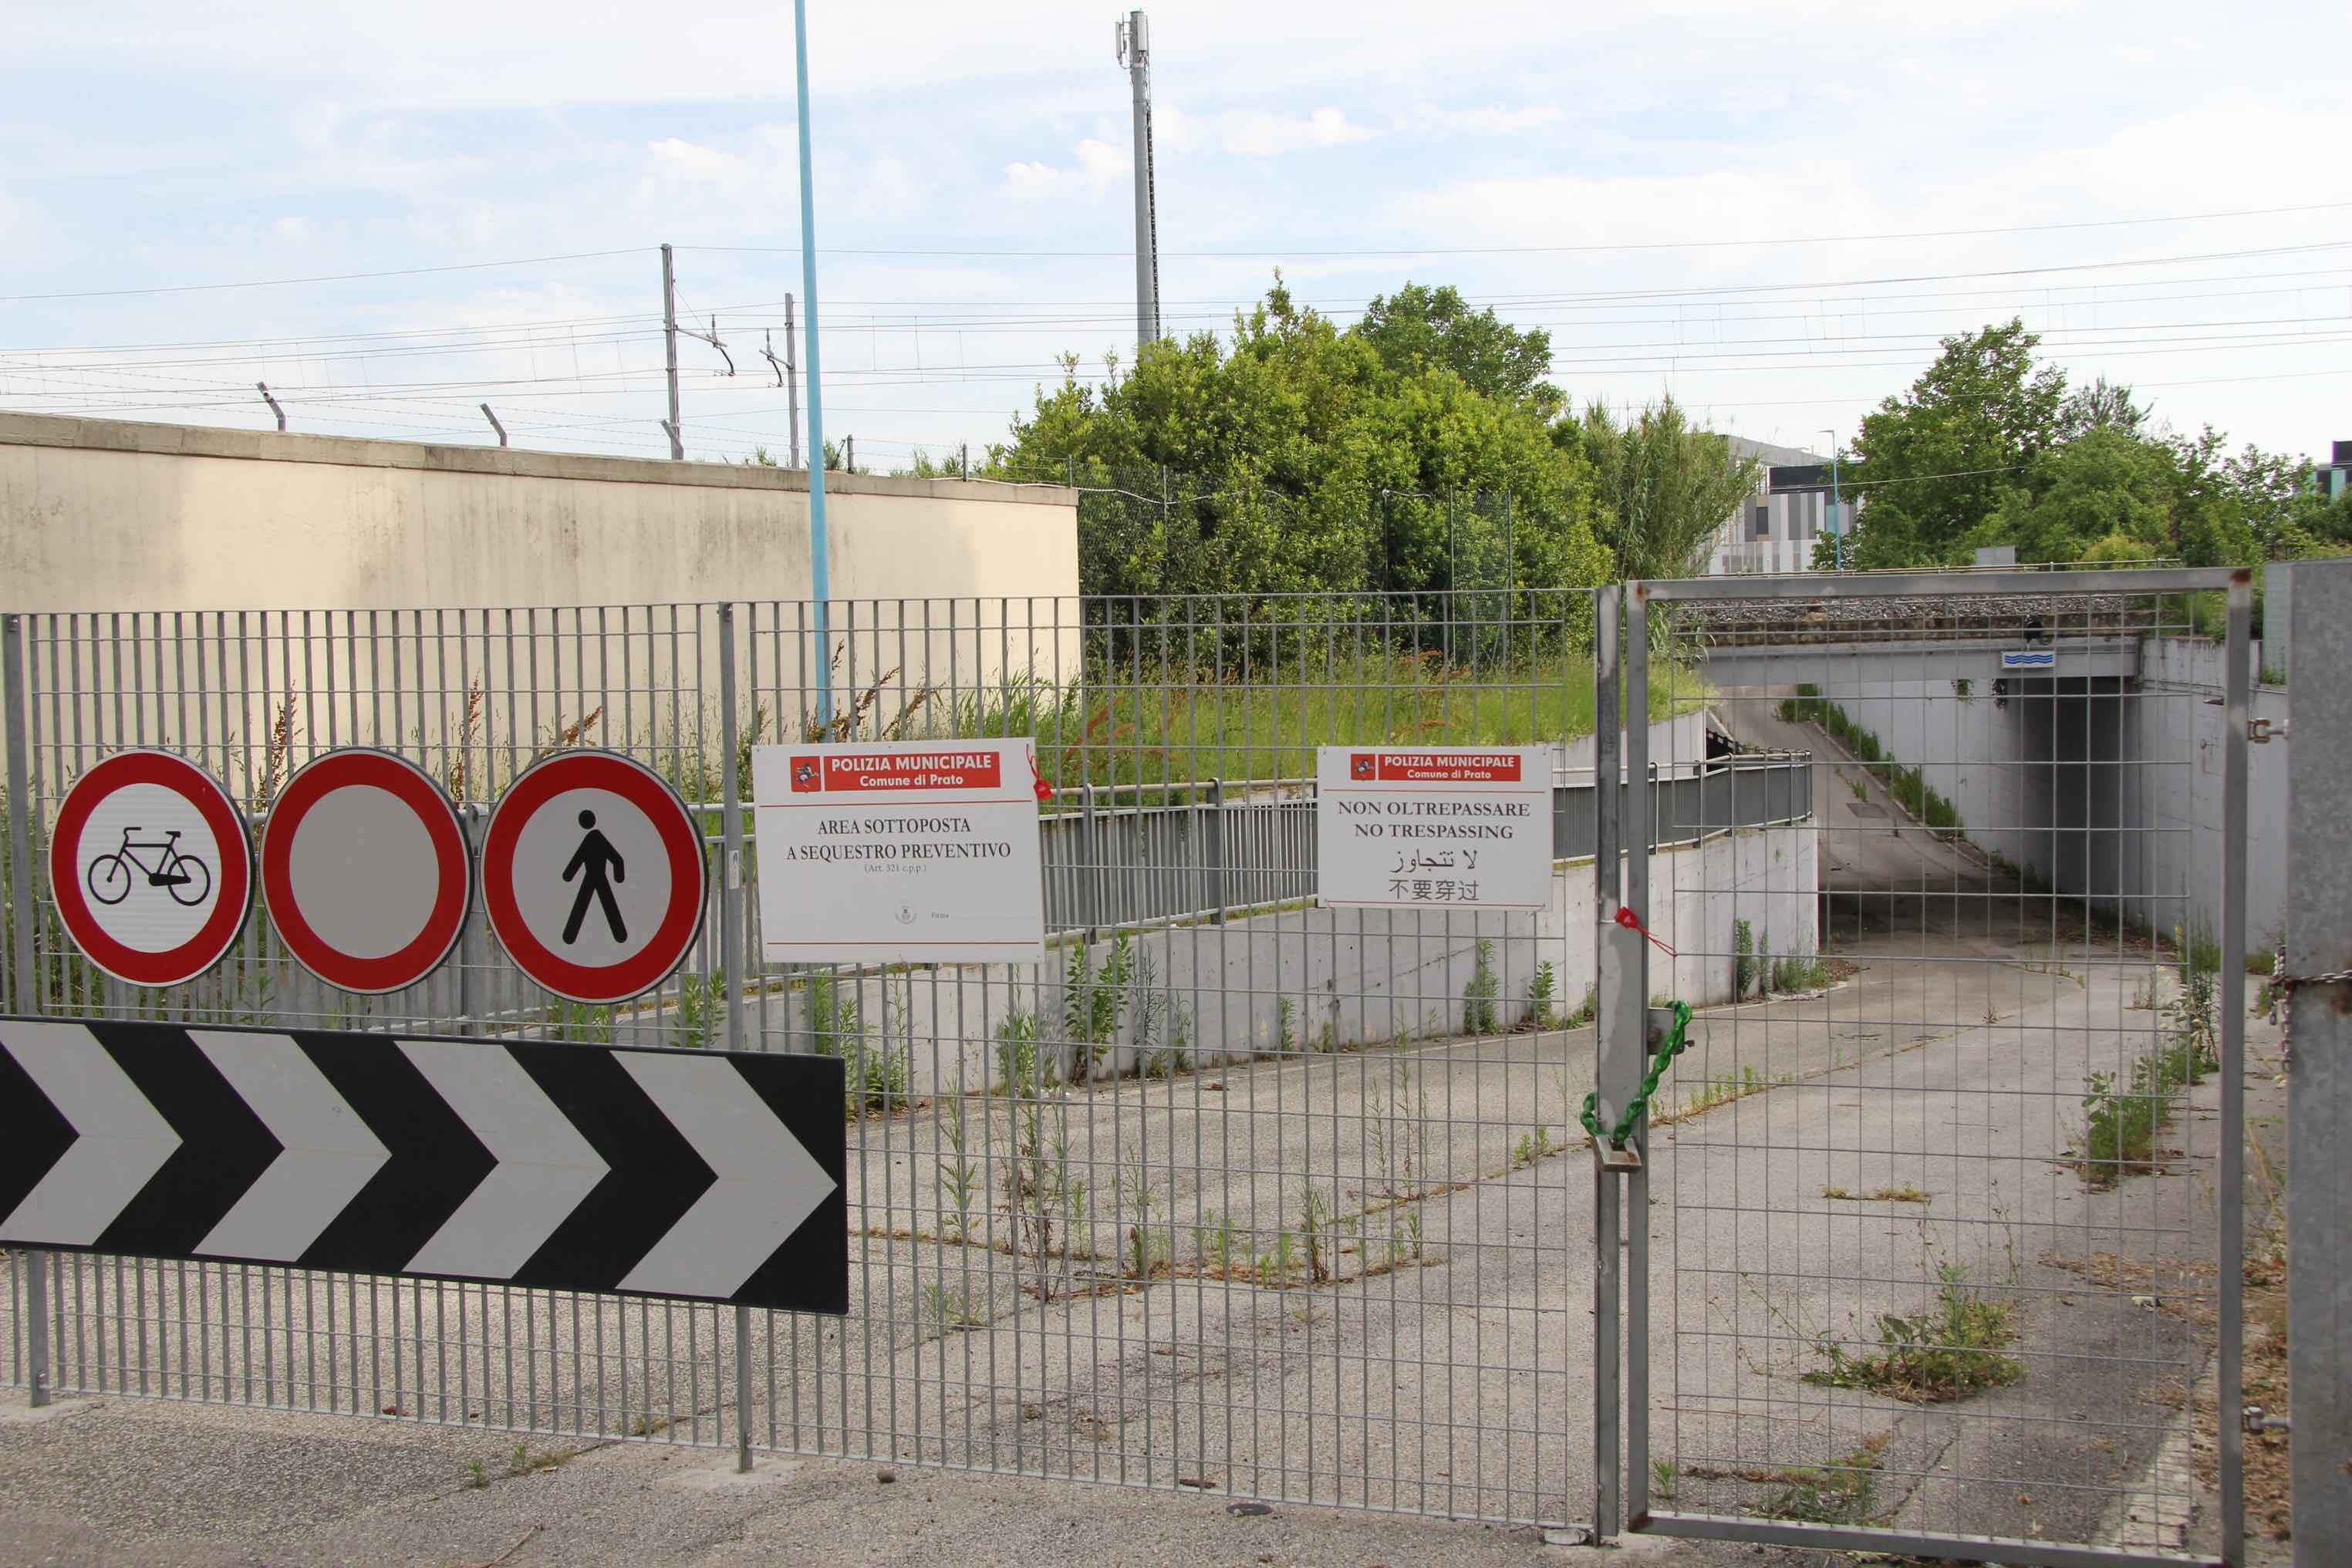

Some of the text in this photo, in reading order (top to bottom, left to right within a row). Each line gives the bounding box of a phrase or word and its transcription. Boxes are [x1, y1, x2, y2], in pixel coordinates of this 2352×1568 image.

[832, 754, 992, 771] POLIZIA MUNICIPALE
[1384, 756, 1515, 767] POLIZIA MUNICIPALE
[859, 774, 964, 787] Comune di Prato
[1407, 770, 1492, 779] Comune di Prato
[1338, 801, 1530, 817] NON OLTREPASSARE
[817, 818, 971, 835] AREA SOTTOPOSTA
[1355, 824, 1513, 839] NO TRESPASSING
[785, 842, 1011, 863] A SEQUESTRO PREVENTIVO
[886, 864, 900, 872] 321
[1390, 849, 1478, 873] لا تتجاوز
[1389, 879, 1480, 901] 不要穿过
